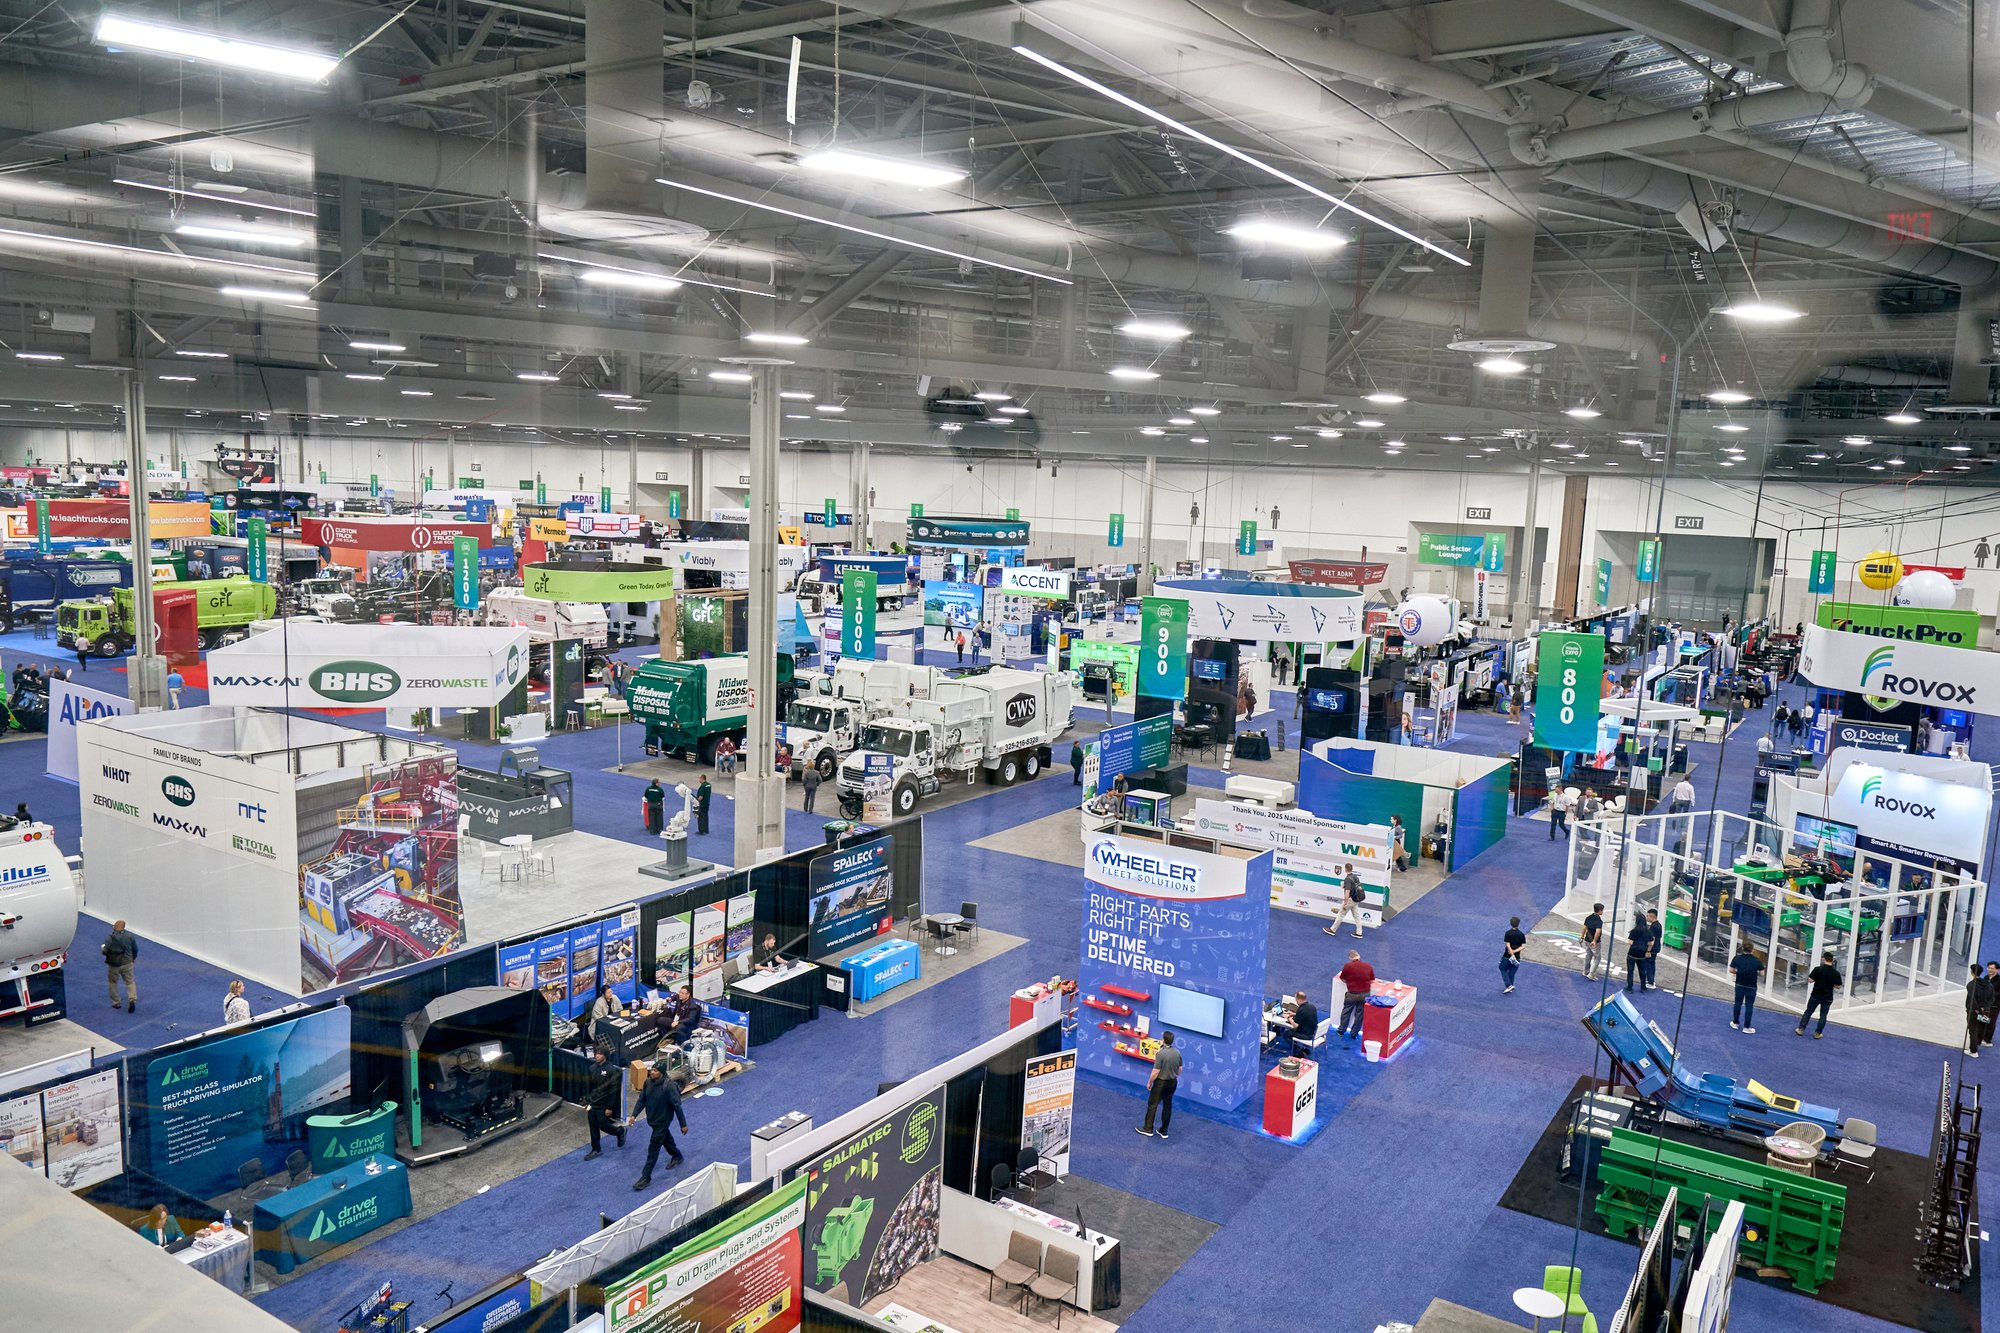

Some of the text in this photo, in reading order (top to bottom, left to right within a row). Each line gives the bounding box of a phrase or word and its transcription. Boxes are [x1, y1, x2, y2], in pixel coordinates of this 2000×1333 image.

[1159, 132, 1179, 158] R7-3
[1689, 251, 1705, 282] W1 R7-4
[721, 514, 747, 522] Balemaster
[1468, 508, 1489, 518] EXIT
[543, 526, 566, 535] Vermeer
[1678, 518, 1701, 528] EXIT
[254, 537, 262, 579] 1300
[1430, 544, 1472, 553] Public Sector
[1438, 551, 1462, 560] Lounge
[1490, 543, 1498, 570] 1000
[691, 555, 716, 567] Viably
[778, 556, 794, 567] ably
[462, 558, 470, 605] 1200
[1011, 574, 1061, 590] ACCENT
[1336, 570, 1354, 578] ADAM
[1818, 564, 1826, 584] 800
[534, 577, 550, 593] GFL
[619, 583, 636, 591] Green
[210, 590, 233, 609] GFL
[692, 602, 713, 624] GFL
[854, 597, 863, 653] 1000
[1832, 618, 1963, 644] TruckPro
[1156, 627, 1169, 676] 900
[320, 672, 393, 692] BHS
[406, 678, 489, 688] ZEROWASTE
[718, 678, 748, 690] Midwe
[1881, 674, 1976, 705] ROVOX
[635, 685, 673, 700] Midwest
[1559, 668, 1577, 724] 800
[632, 696, 670, 709] DISPOSAL
[1006, 696, 1035, 719] CWS
[1859, 729, 1900, 742] Docket
[153, 748, 202, 767] FAMILY OF BRANDS
[102, 764, 130, 784] NIHOT
[165, 782, 192, 801] BHS
[93, 793, 140, 818] ZEROWASTE
[238, 801, 267, 824] nrt
[1875, 795, 1936, 820] ROVOX
[486, 816, 498, 826] AIR
[1232, 805, 1346, 831] Thank You, 2025 National Sponsors!
[1278, 822, 1296, 830] Titanium
[245, 838, 276, 856] TOTAL
[1269, 830, 1301, 846] STIFEL
[1341, 842, 1376, 859] WM
[1870, 838, 1957, 866] Smart AI, Smarter Recycling.
[833, 849, 873, 873] SPALECK
[1100, 850, 1196, 883] WHEELER
[1276, 856, 1288, 866] BTR
[1102, 866, 1196, 893] FLEET SOLUTIONS
[1273, 876, 1294, 885] waste
[1283, 870, 1298, 878] Partner
[2, 877, 51, 892] Corporation Business
[816, 882, 835, 894] LEADING
[834, 879, 845, 887] EDGE
[1090, 893, 1190, 928] RIGHT PARTS
[1090, 911, 1163, 938] RIGHT FIT
[1089, 928, 1147, 955] UPTIME
[1088, 944, 1175, 978] DELIVERED
[181, 1062, 208, 1076] driver
[181, 1068, 209, 1081] training
[1028, 1057, 1074, 1078] stela
[48, 1092, 79, 1106] Intelligent
[162, 1080, 219, 1104] BEST-IN-CLASS
[163, 1074, 263, 1111] TRUCK DRIVING SIMULATOR
[163, 1115, 184, 1125] Features:
[167, 1114, 212, 1131] Improve Driver Safety
[167, 1130, 184, 1138] Reduce
[184, 1123, 201, 1132] Number
[205, 1118, 222, 1126] Severity
[227, 1110, 244, 1118] Crashes
[168, 1128, 209, 1145] Standardize Training
[180, 1136, 206, 1149] Performance
[350, 1132, 385, 1149] driver
[168, 1150, 184, 1158] Reduce
[185, 1144, 201, 1152] Training
[180, 1154, 193, 1162] Driver
[193, 1146, 217, 1157] Confidence
[350, 1142, 385, 1157] training
[822, 1122, 892, 1174] SALMATEC
[338, 1195, 377, 1219] driver
[338, 1206, 378, 1229] training
[676, 1206, 800, 1287] Oil Drain Plugs and Systems
[704, 1232, 778, 1282] Cleaner, Faster and Safer!
[754, 1252, 766, 1262] Hose
[483, 1302, 521, 1327] EQUIPMENT
[486, 1298, 517, 1320] ORIGINAL
[665, 1306, 679, 1319] Drain
[679, 1296, 694, 1310] Plugs
[619, 1311, 639, 1326] Change
